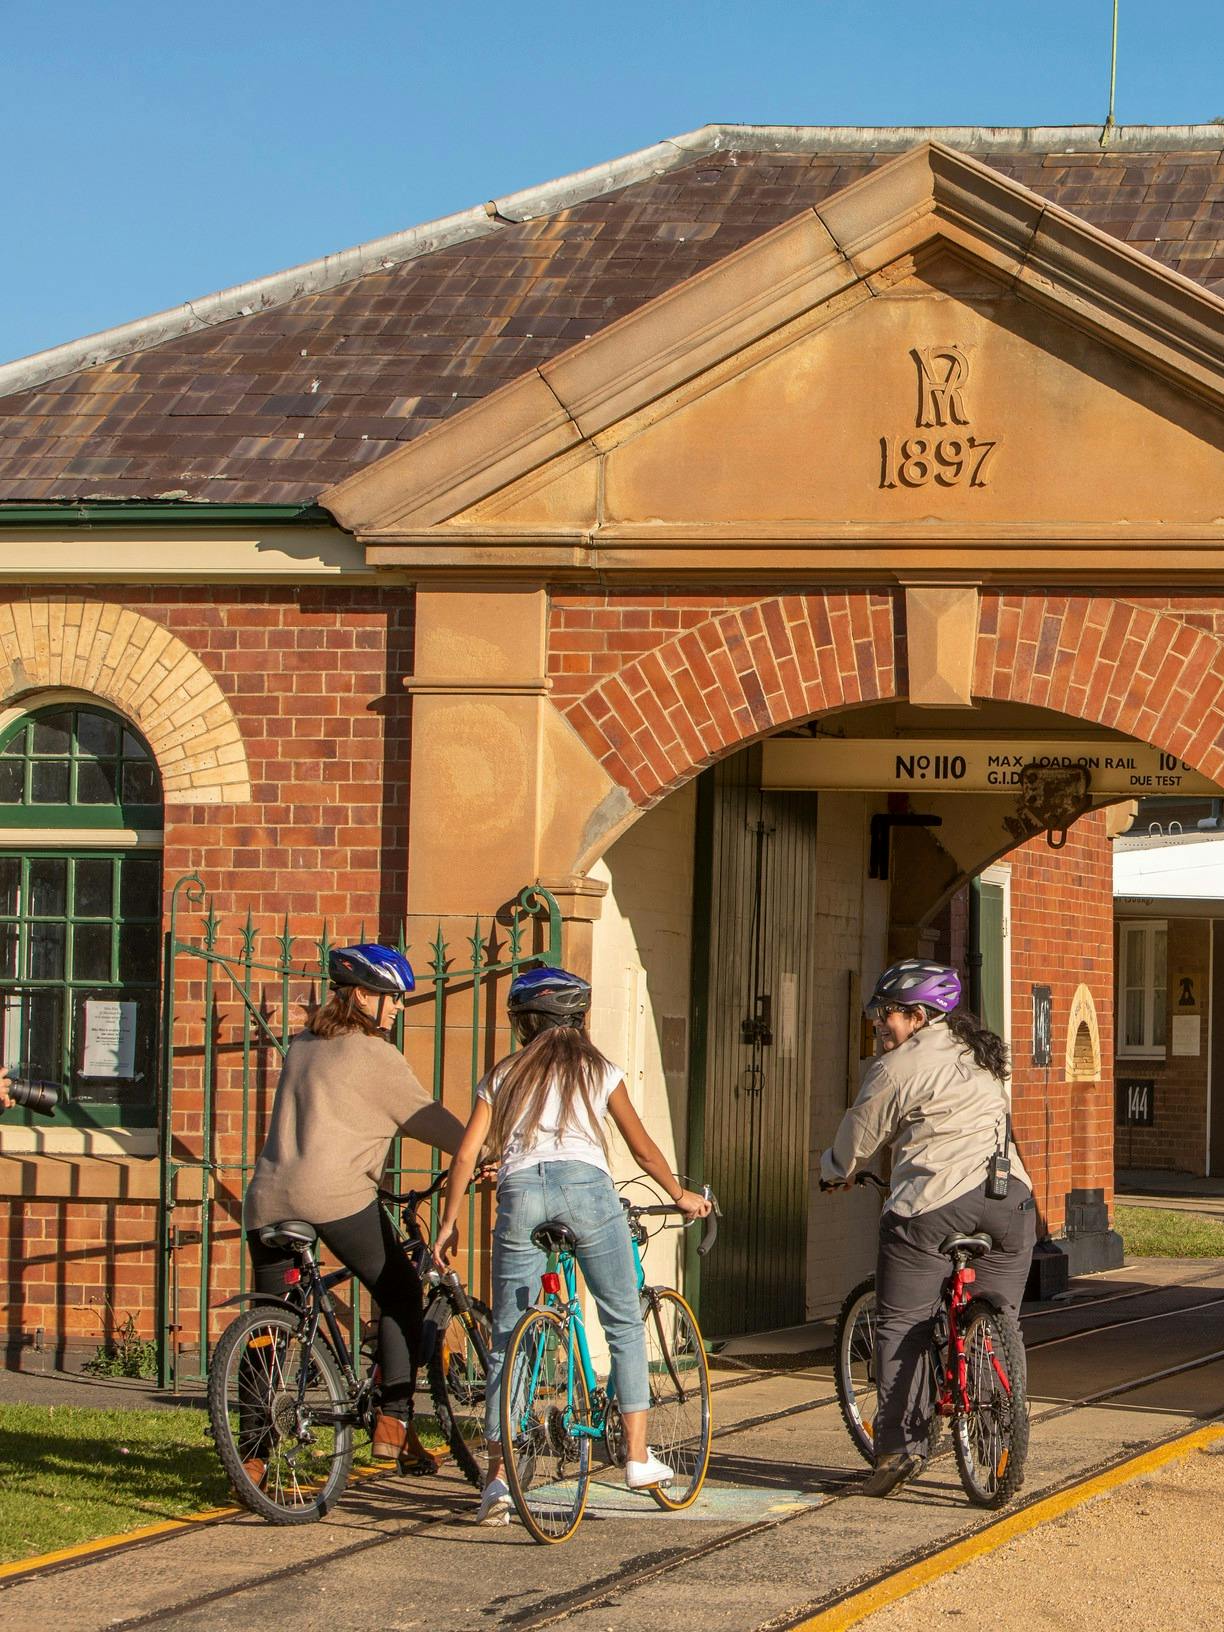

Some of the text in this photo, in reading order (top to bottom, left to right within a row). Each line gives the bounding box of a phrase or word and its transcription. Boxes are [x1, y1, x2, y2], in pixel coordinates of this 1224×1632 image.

[879, 436, 998, 489] 1897
[988, 756, 1023, 767] MAX
[1078, 757, 1100, 769] ON
[1105, 757, 1136, 769] RAIL
[1160, 753, 1177, 771] 10
[1130, 775, 1152, 786] DUE
[1155, 775, 1182, 787] TEST
[1128, 1086, 1147, 1120] 144
